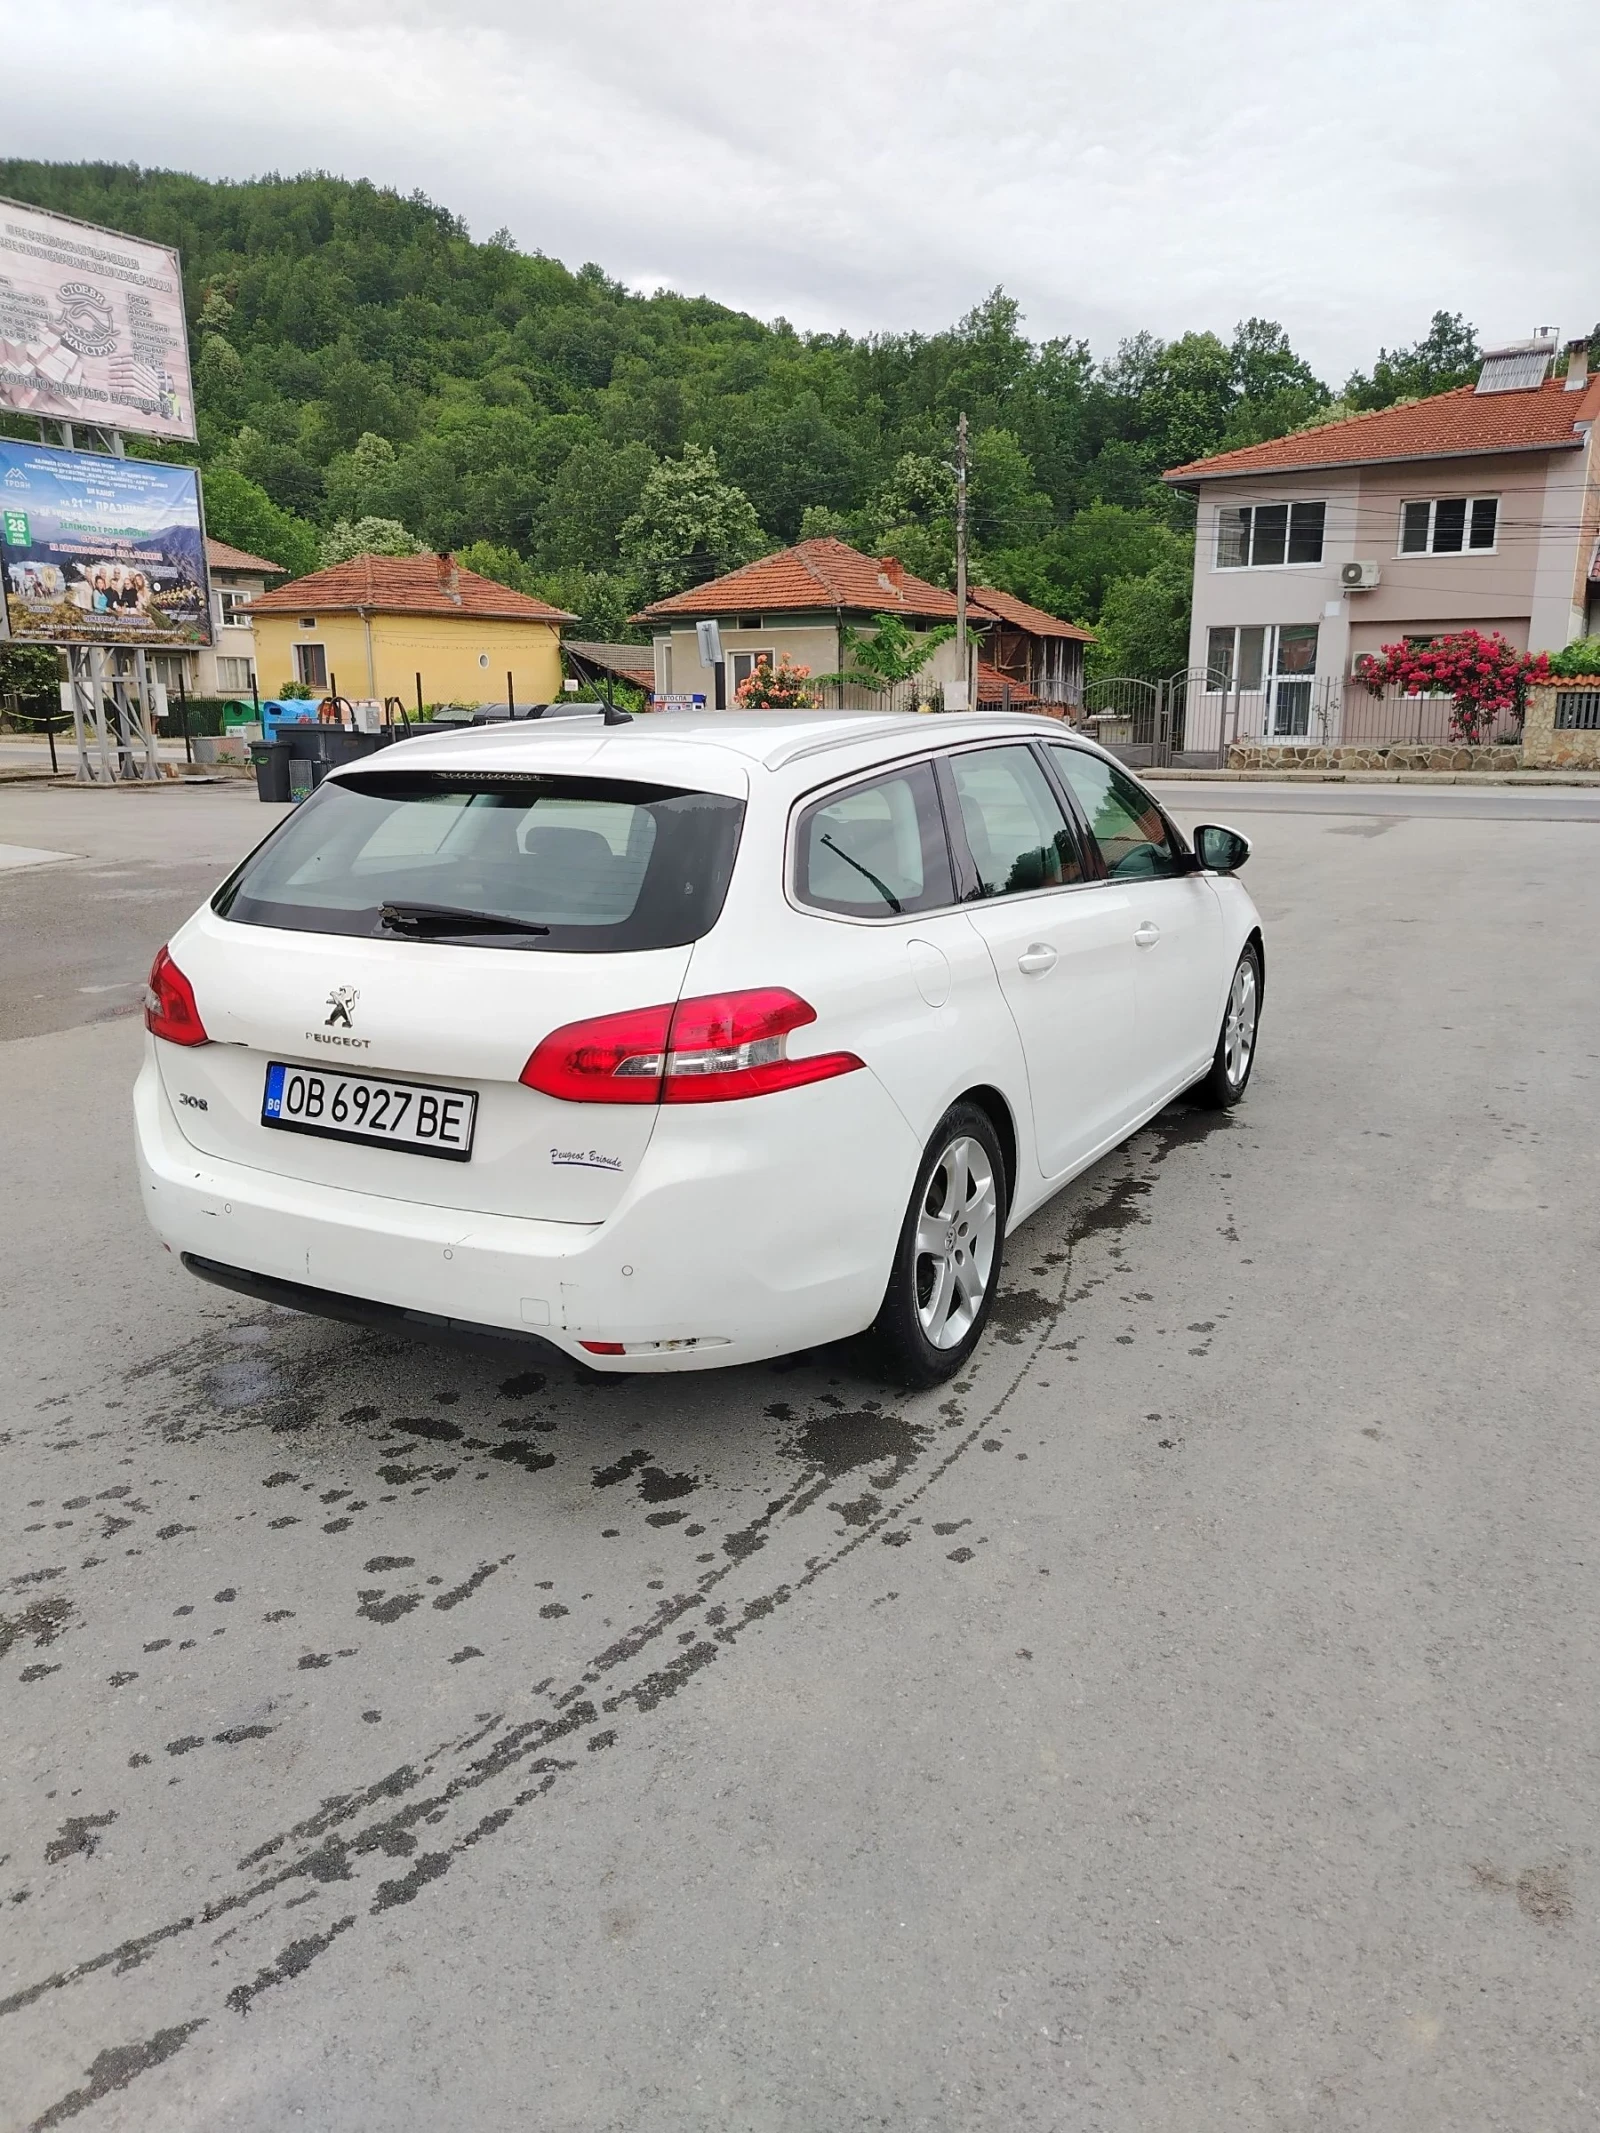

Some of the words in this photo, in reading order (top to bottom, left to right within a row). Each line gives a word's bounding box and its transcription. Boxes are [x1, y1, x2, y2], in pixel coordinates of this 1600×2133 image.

[61, 284, 105, 304] СТОЕВИ
[4, 479, 31, 488] ТРОЯН
[8, 518, 27, 533] 28
[305, 1032, 371, 1049] PEUGEOT
[178, 1093, 209, 1112] 308
[267, 1098, 281, 1112] BG
[287, 1075, 325, 1118] OB
[331, 1082, 412, 1132] 6927
[416, 1095, 464, 1143] BE
[550, 1148, 585, 1162] Peugeot
